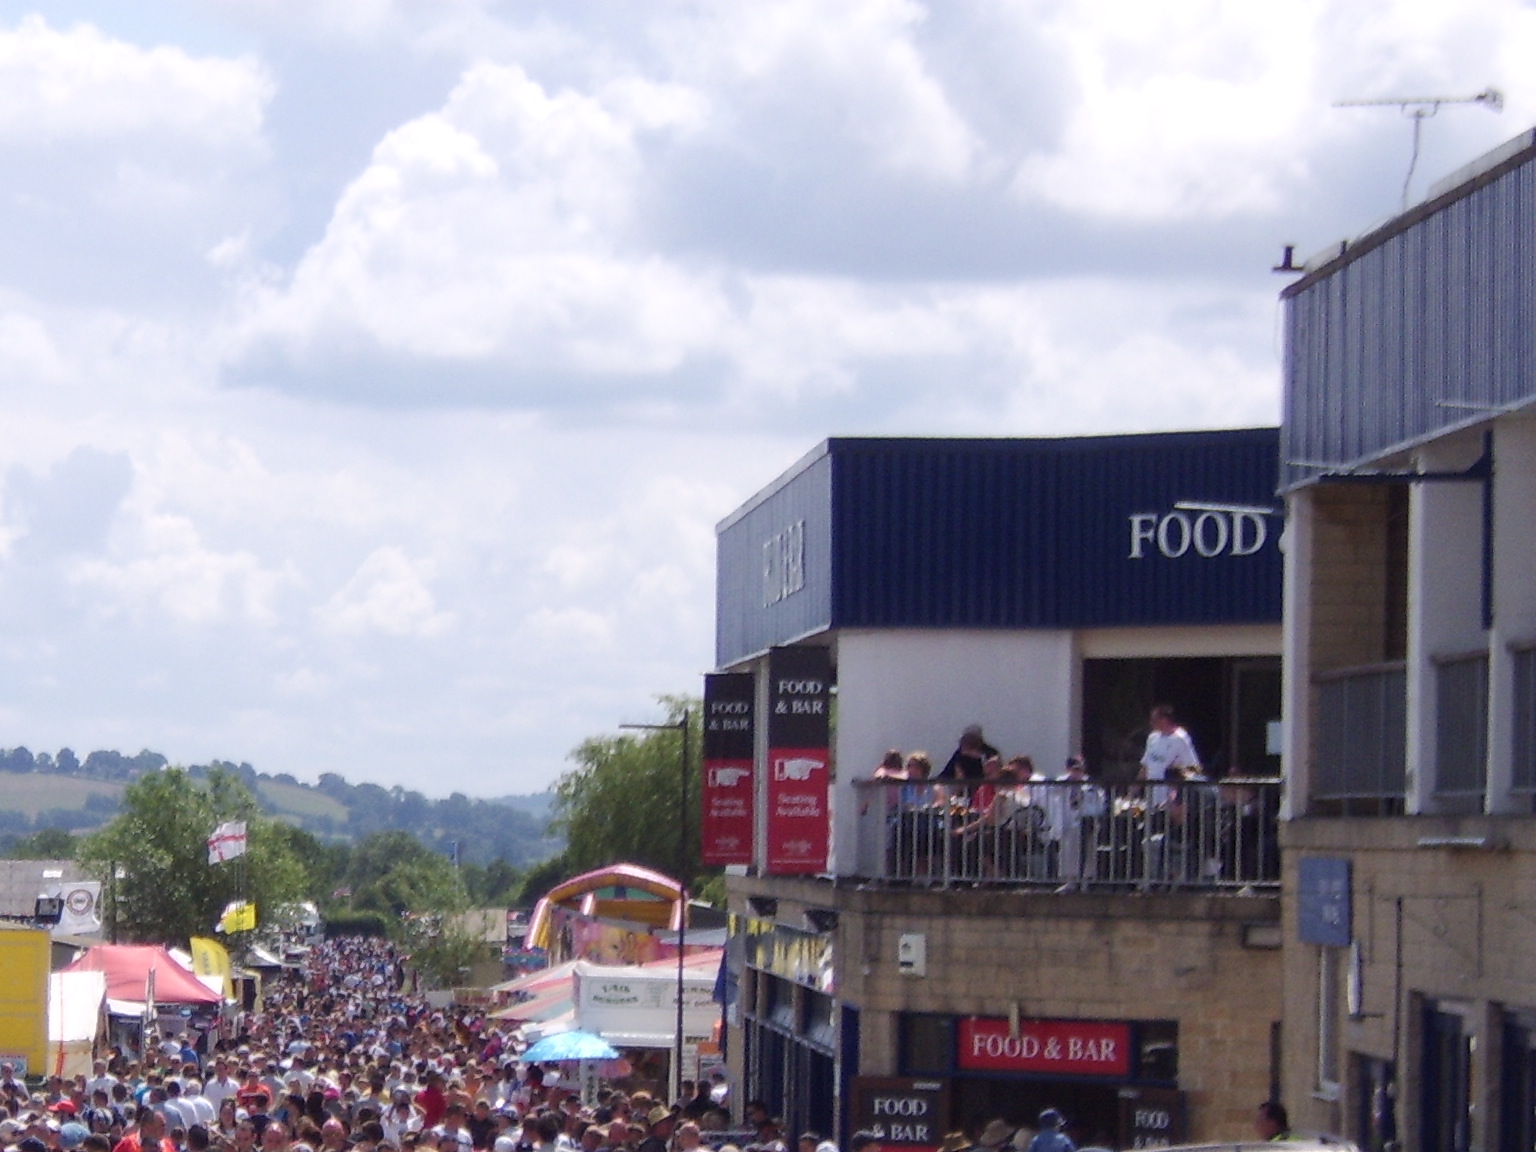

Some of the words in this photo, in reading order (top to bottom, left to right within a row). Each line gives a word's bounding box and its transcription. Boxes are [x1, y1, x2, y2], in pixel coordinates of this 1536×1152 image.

[1128, 511, 1268, 559] FOOD
[777, 679, 823, 695] FOOD
[711, 702, 749, 715] FOOD
[774, 701, 788, 715] &
[791, 700, 824, 715] BAR
[708, 719, 719, 731] &
[722, 719, 750, 731] BAR
[972, 1033, 1040, 1058] FOOD
[1043, 1036, 1062, 1060] &
[1068, 1037, 1117, 1062] BAR
[873, 1097, 929, 1116] FOOD
[1135, 1109, 1170, 1130] FOOD
[872, 1122, 885, 1138] &
[889, 1122, 929, 1141] BAR
